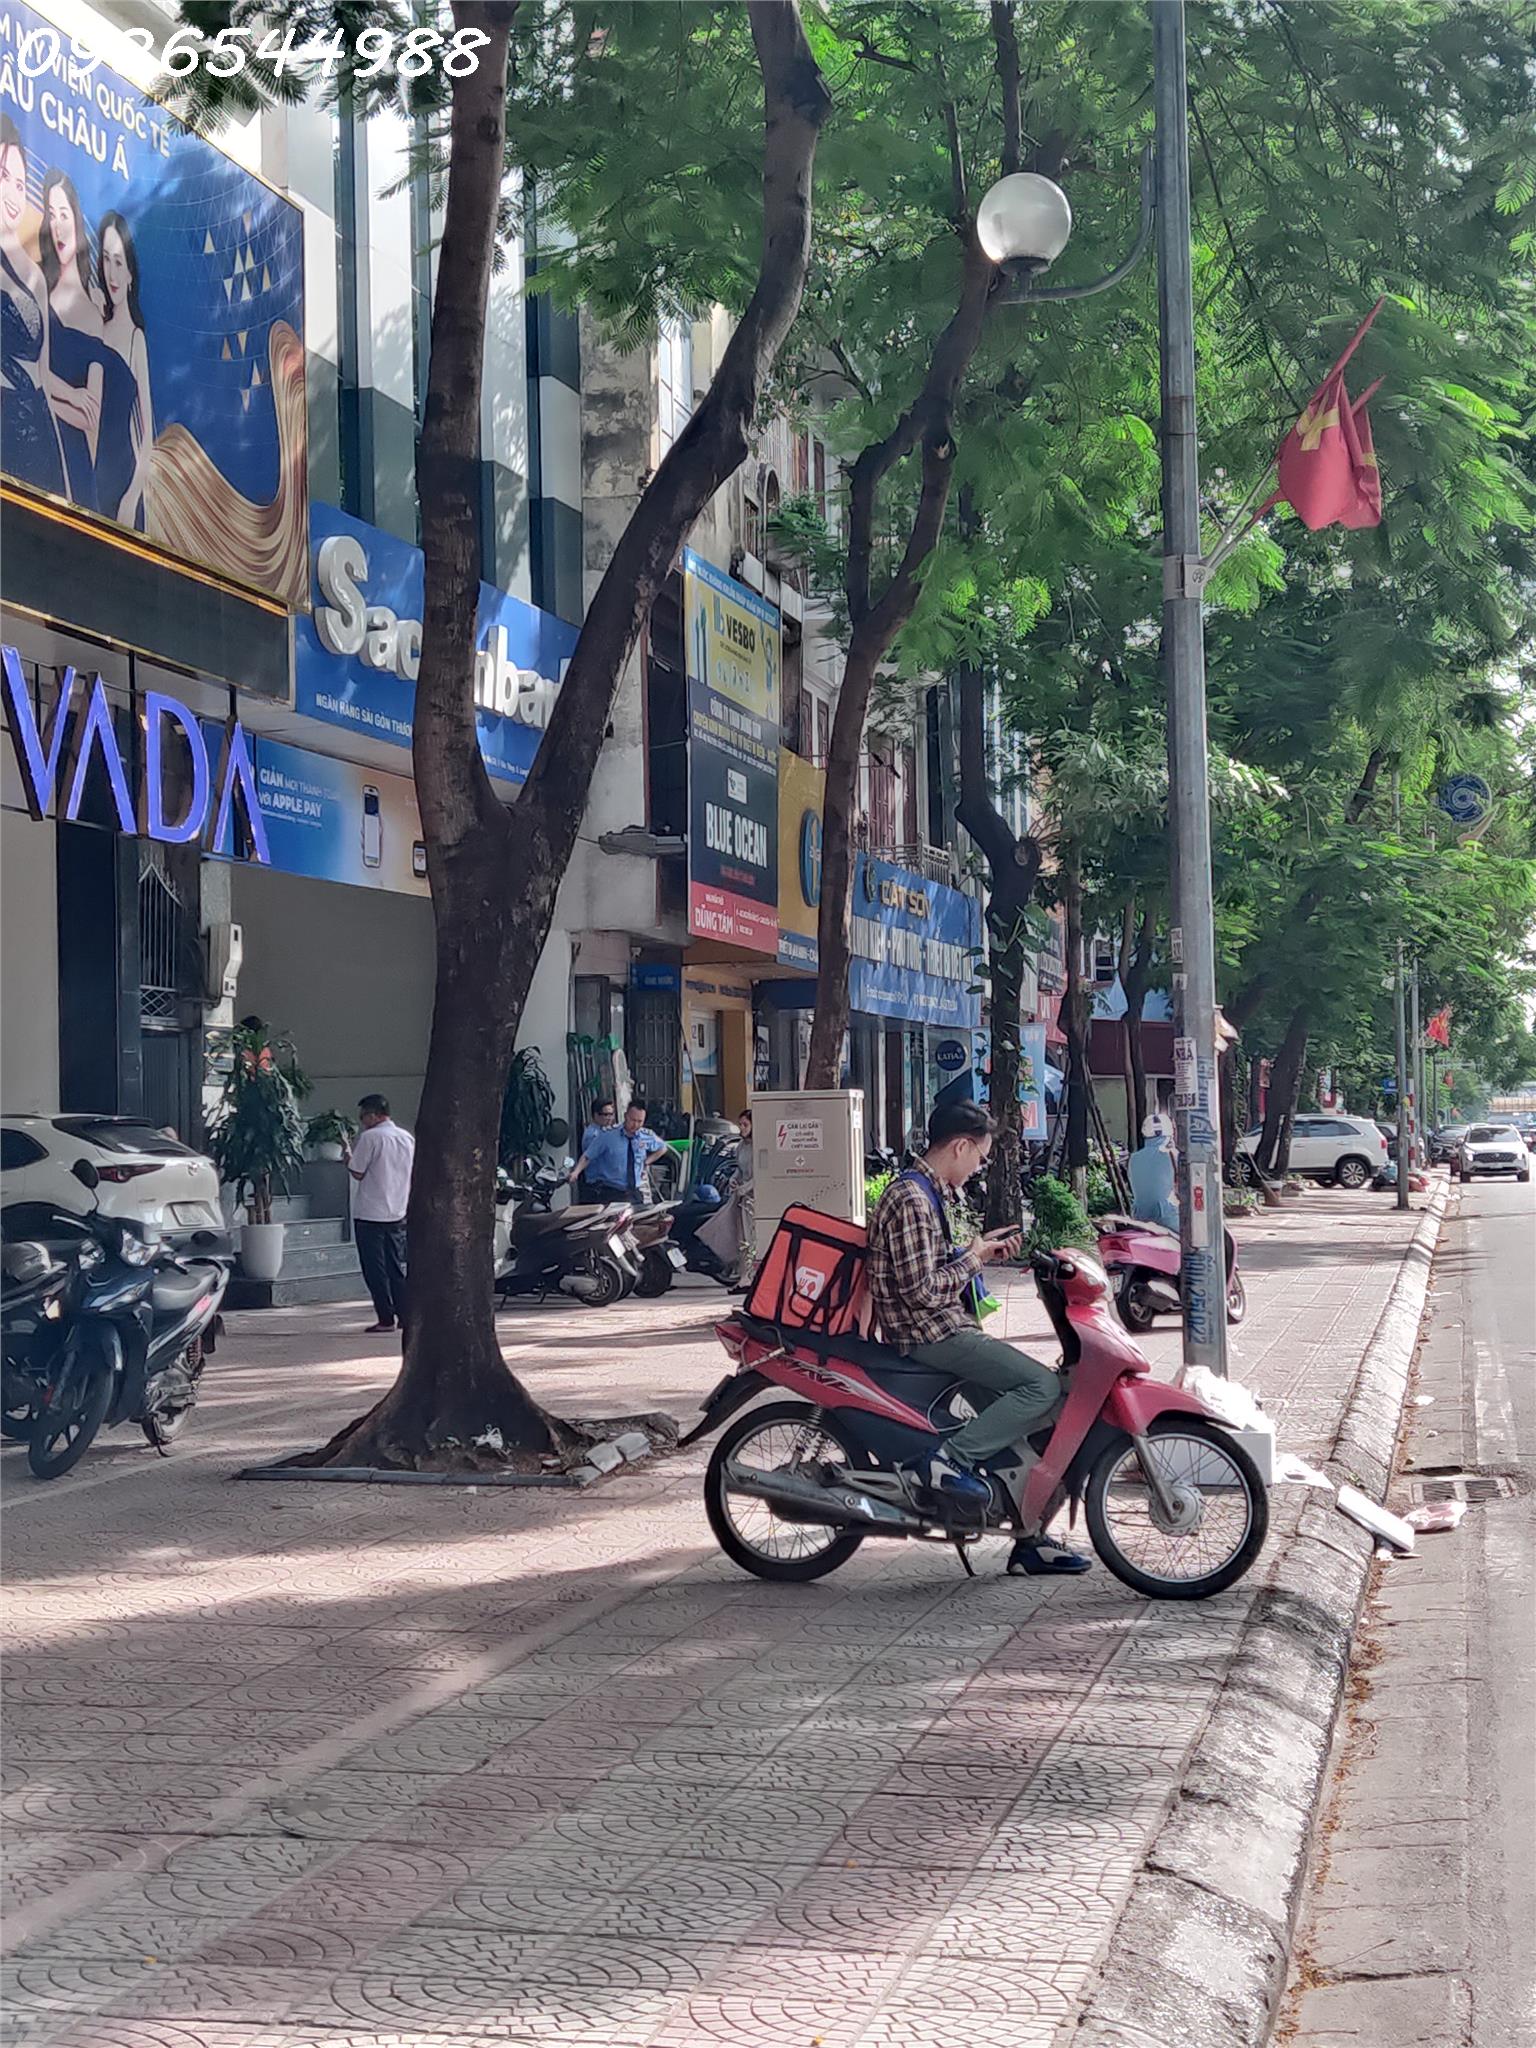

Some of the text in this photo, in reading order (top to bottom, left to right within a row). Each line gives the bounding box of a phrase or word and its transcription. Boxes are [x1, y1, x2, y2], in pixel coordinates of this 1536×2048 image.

[41, 91, 107, 163] CHÂU
[112, 135, 130, 181] Á
[96, 82, 147, 141] QUỐC
[150, 120, 171, 158] TẾ
[726, 613, 756, 654] VESBO
[316, 693, 339, 713] NGÂN
[339, 700, 360, 721] HÀNG
[361, 706, 374, 726] SÀI
[374, 711, 391, 732] GÒN
[1, 647, 272, 865] VADA
[260, 765, 284, 788] GIẢN
[272, 793, 303, 813] APPLE
[303, 801, 322, 818] PAY
[705, 802, 768, 868] BLUE OCEAN
